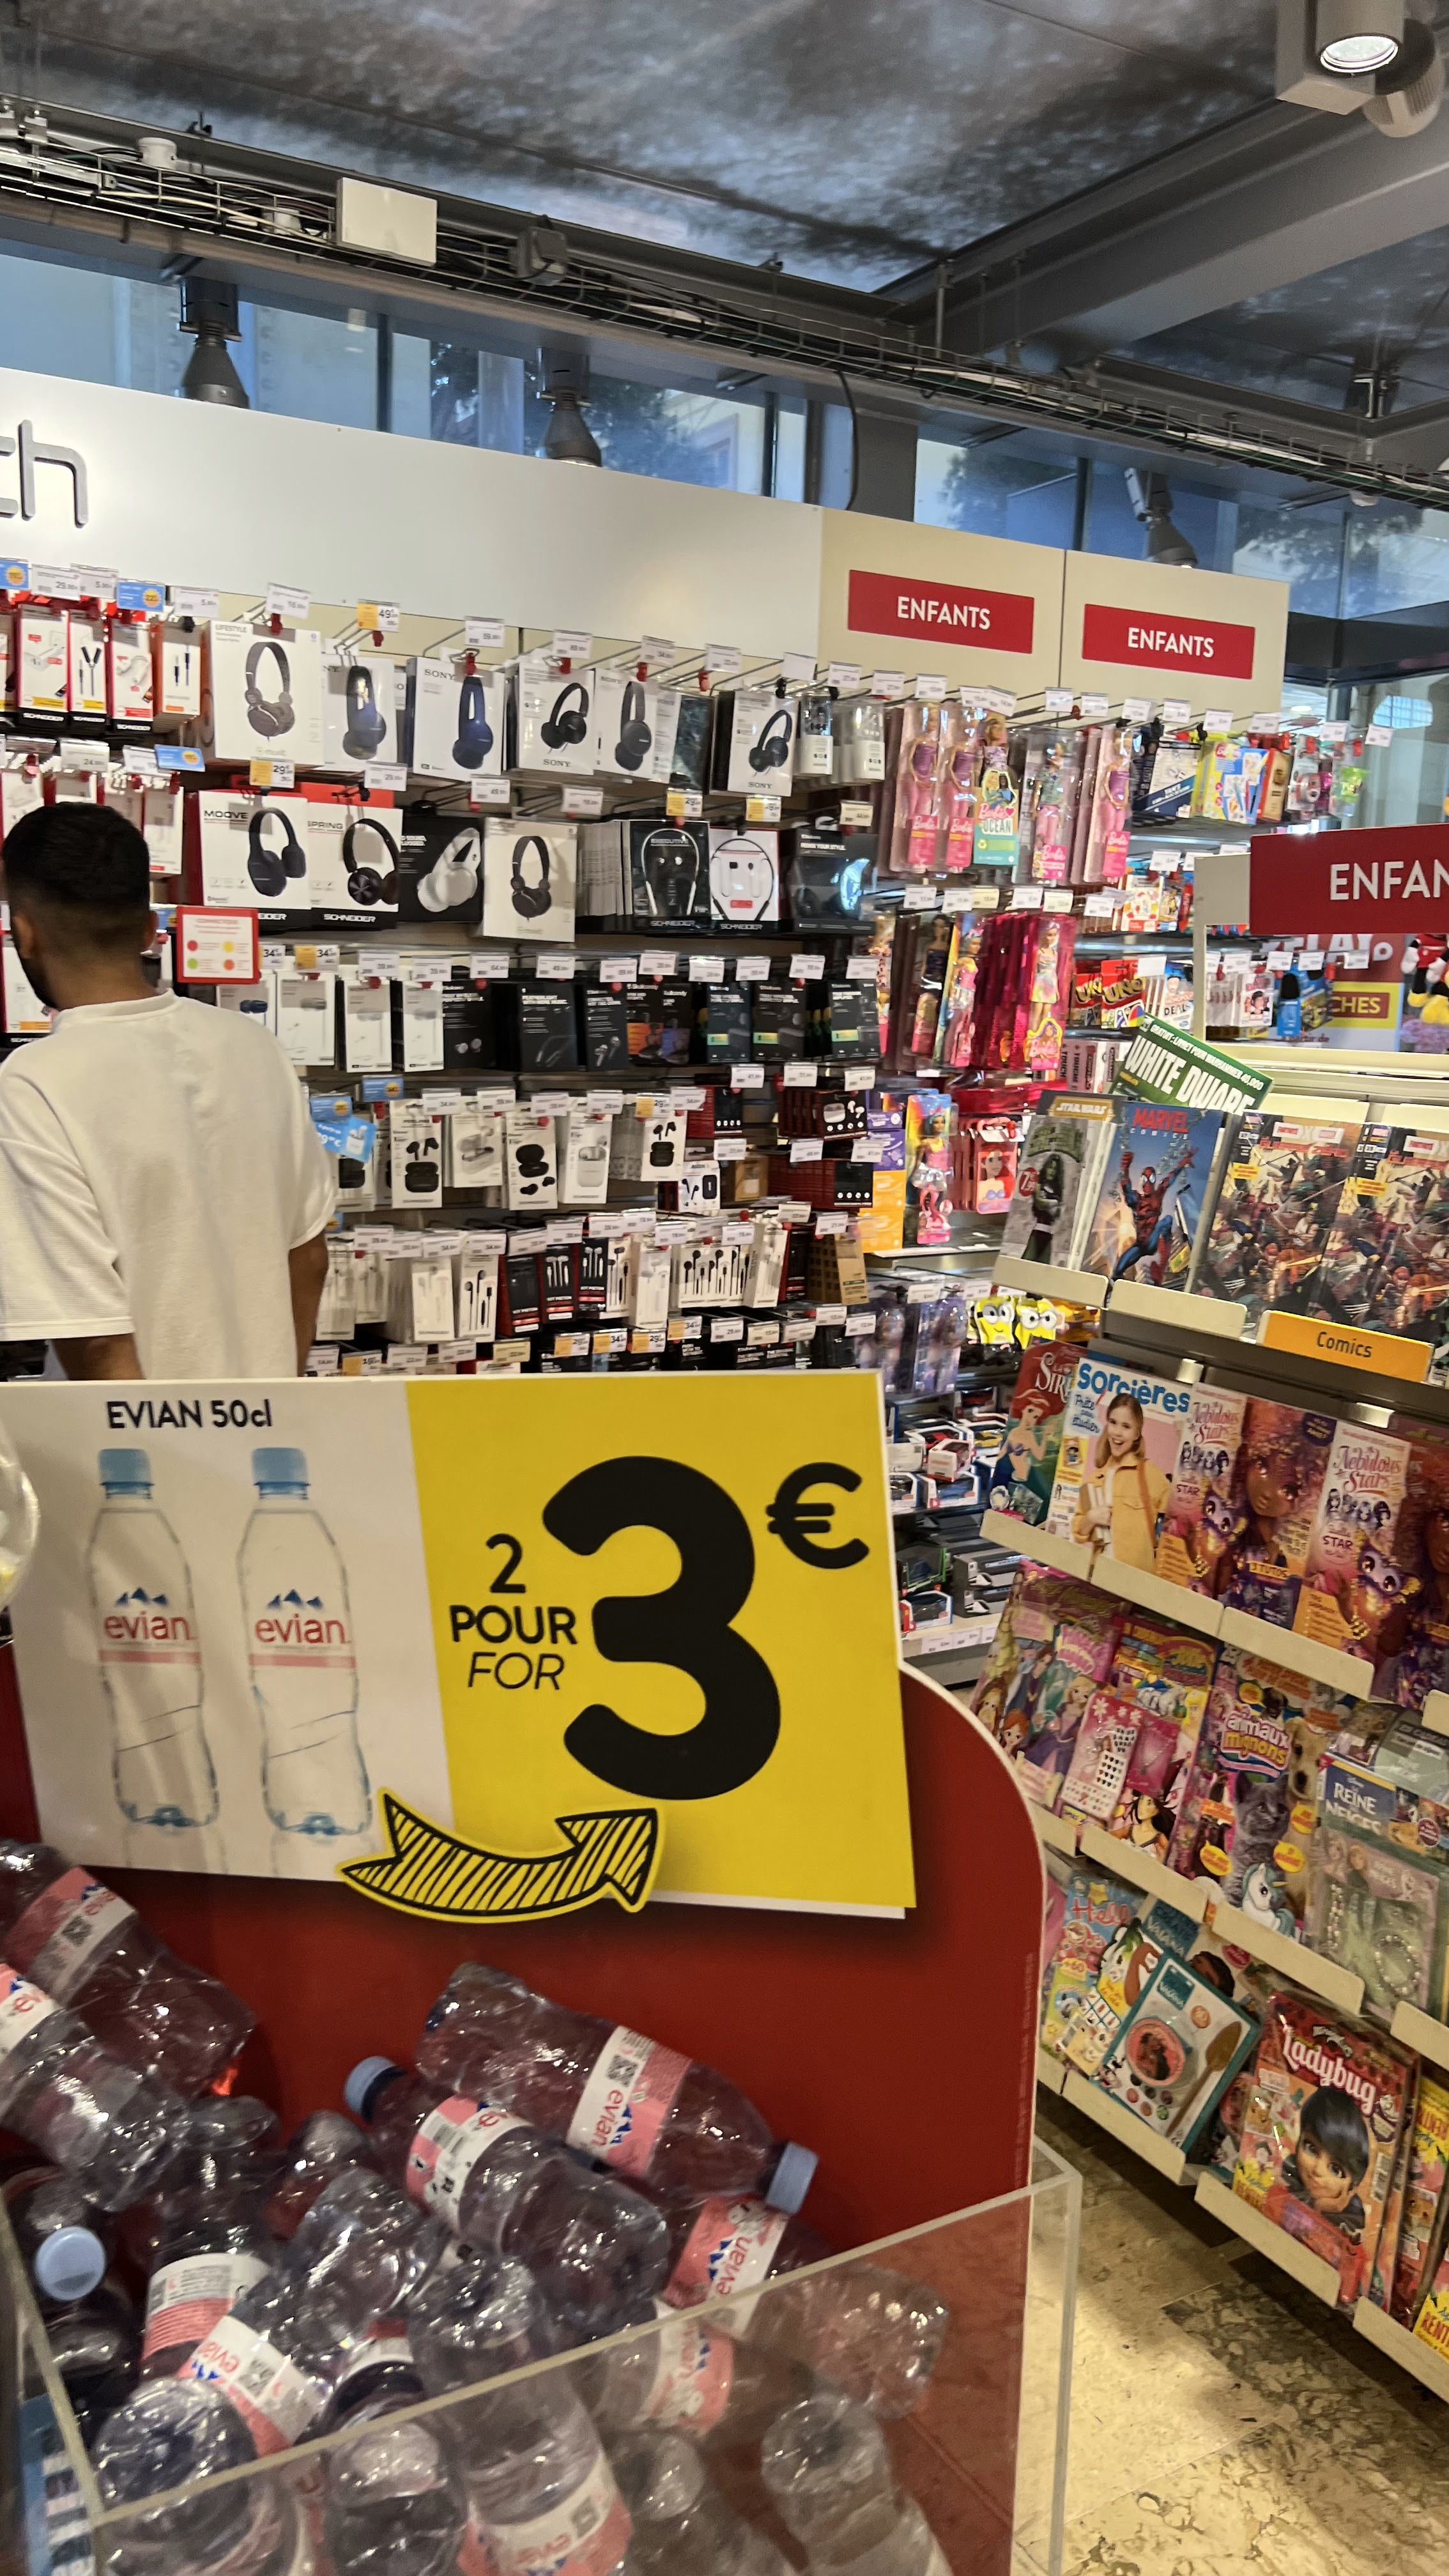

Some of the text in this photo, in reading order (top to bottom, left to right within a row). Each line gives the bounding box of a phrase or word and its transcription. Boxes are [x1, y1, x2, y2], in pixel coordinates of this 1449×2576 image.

[896, 596, 991, 631] ENFANTS
[1128, 627, 1215, 659] ENFANTS
[424, 669, 456, 680] SONY
[542, 759, 571, 767] SONY
[748, 781, 772, 790] SONY
[204, 810, 248, 819] MOOVE
[1103, 977, 1145, 1004] UNO
[1124, 1035, 1186, 1095] WHITE
[1056, 1103, 1108, 1115] STAR WARS
[1132, 1108, 1189, 1133] MARVEL
[1317, 1331, 1373, 1358] Comics
[107, 1399, 273, 1429] EVIAN 50cl
[1322, 1535, 1354, 1551] STAR
[486, 1533, 526, 1594] 2
[103, 1610, 191, 1641] evian
[254, 1613, 346, 1644] evian
[449, 1605, 578, 1645] POUR
[468, 1651, 565, 1690] FOR
[1227, 1713, 1289, 1747] animaux
[1333, 1782, 1377, 1816] REINE
[1282, 2024, 1377, 2116] Ladybug
[591, 2088, 624, 2148] evian
[713, 2235, 751, 2297] evian
